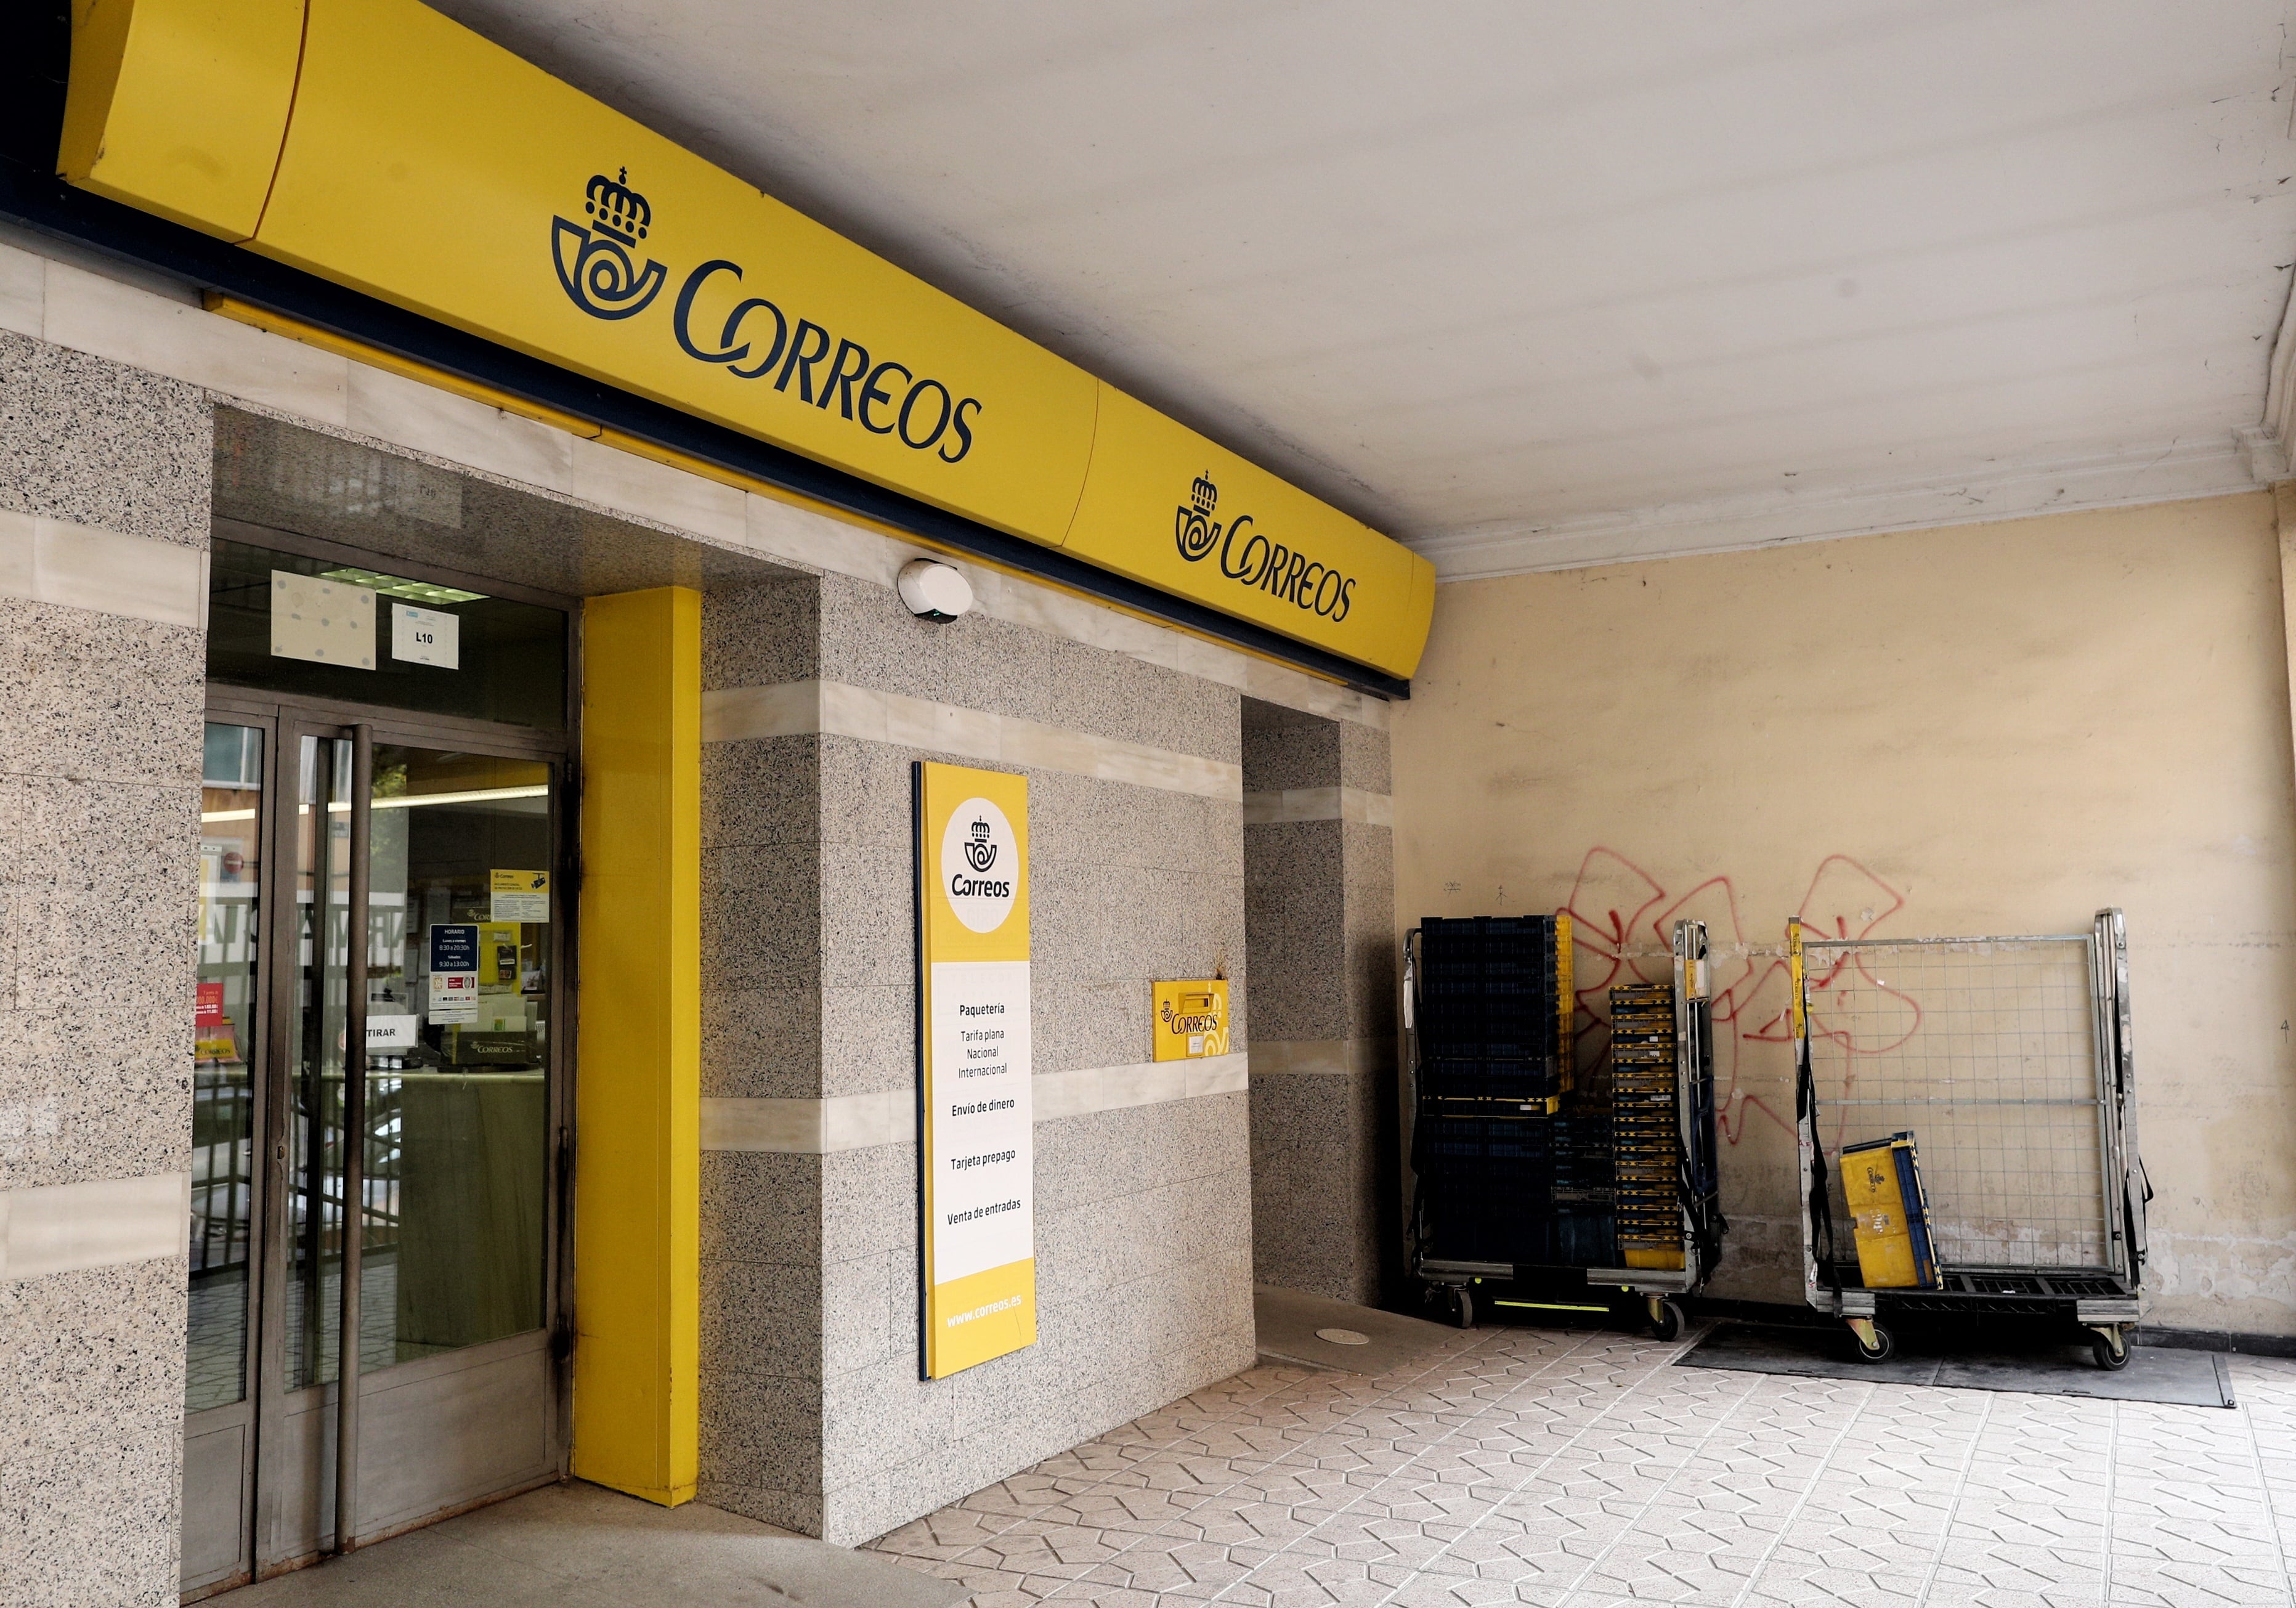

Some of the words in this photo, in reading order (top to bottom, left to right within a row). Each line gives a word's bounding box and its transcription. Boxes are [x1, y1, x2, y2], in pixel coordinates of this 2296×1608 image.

[673, 259, 983, 464] CORREOS
[1220, 514, 1357, 623] CORREOS
[416, 631, 433, 644] L10
[952, 873, 1010, 898] Correos
[959, 1002, 1005, 1018] Paquetería
[366, 1028, 396, 1037] TIRAR
[1171, 1013, 1218, 1035] CORREOS
[960, 1029, 983, 1042] Tarifa
[984, 1028, 1005, 1043] plana
[478, 1046, 513, 1054] CORREOS
[967, 1045, 999, 1060] Nacional
[958, 1062, 1008, 1079] Internacional
[952, 1102, 976, 1117] Envío
[976, 1100, 988, 1113] de
[988, 1098, 1015, 1111] dinero
[951, 1155, 981, 1171] Tarjeta
[982, 1149, 1016, 1167] prepago
[947, 1210, 973, 1226] Venta
[973, 1206, 984, 1219] de
[984, 1198, 1021, 1216] entradas
[946, 1294, 1023, 1328] www.correos.es
